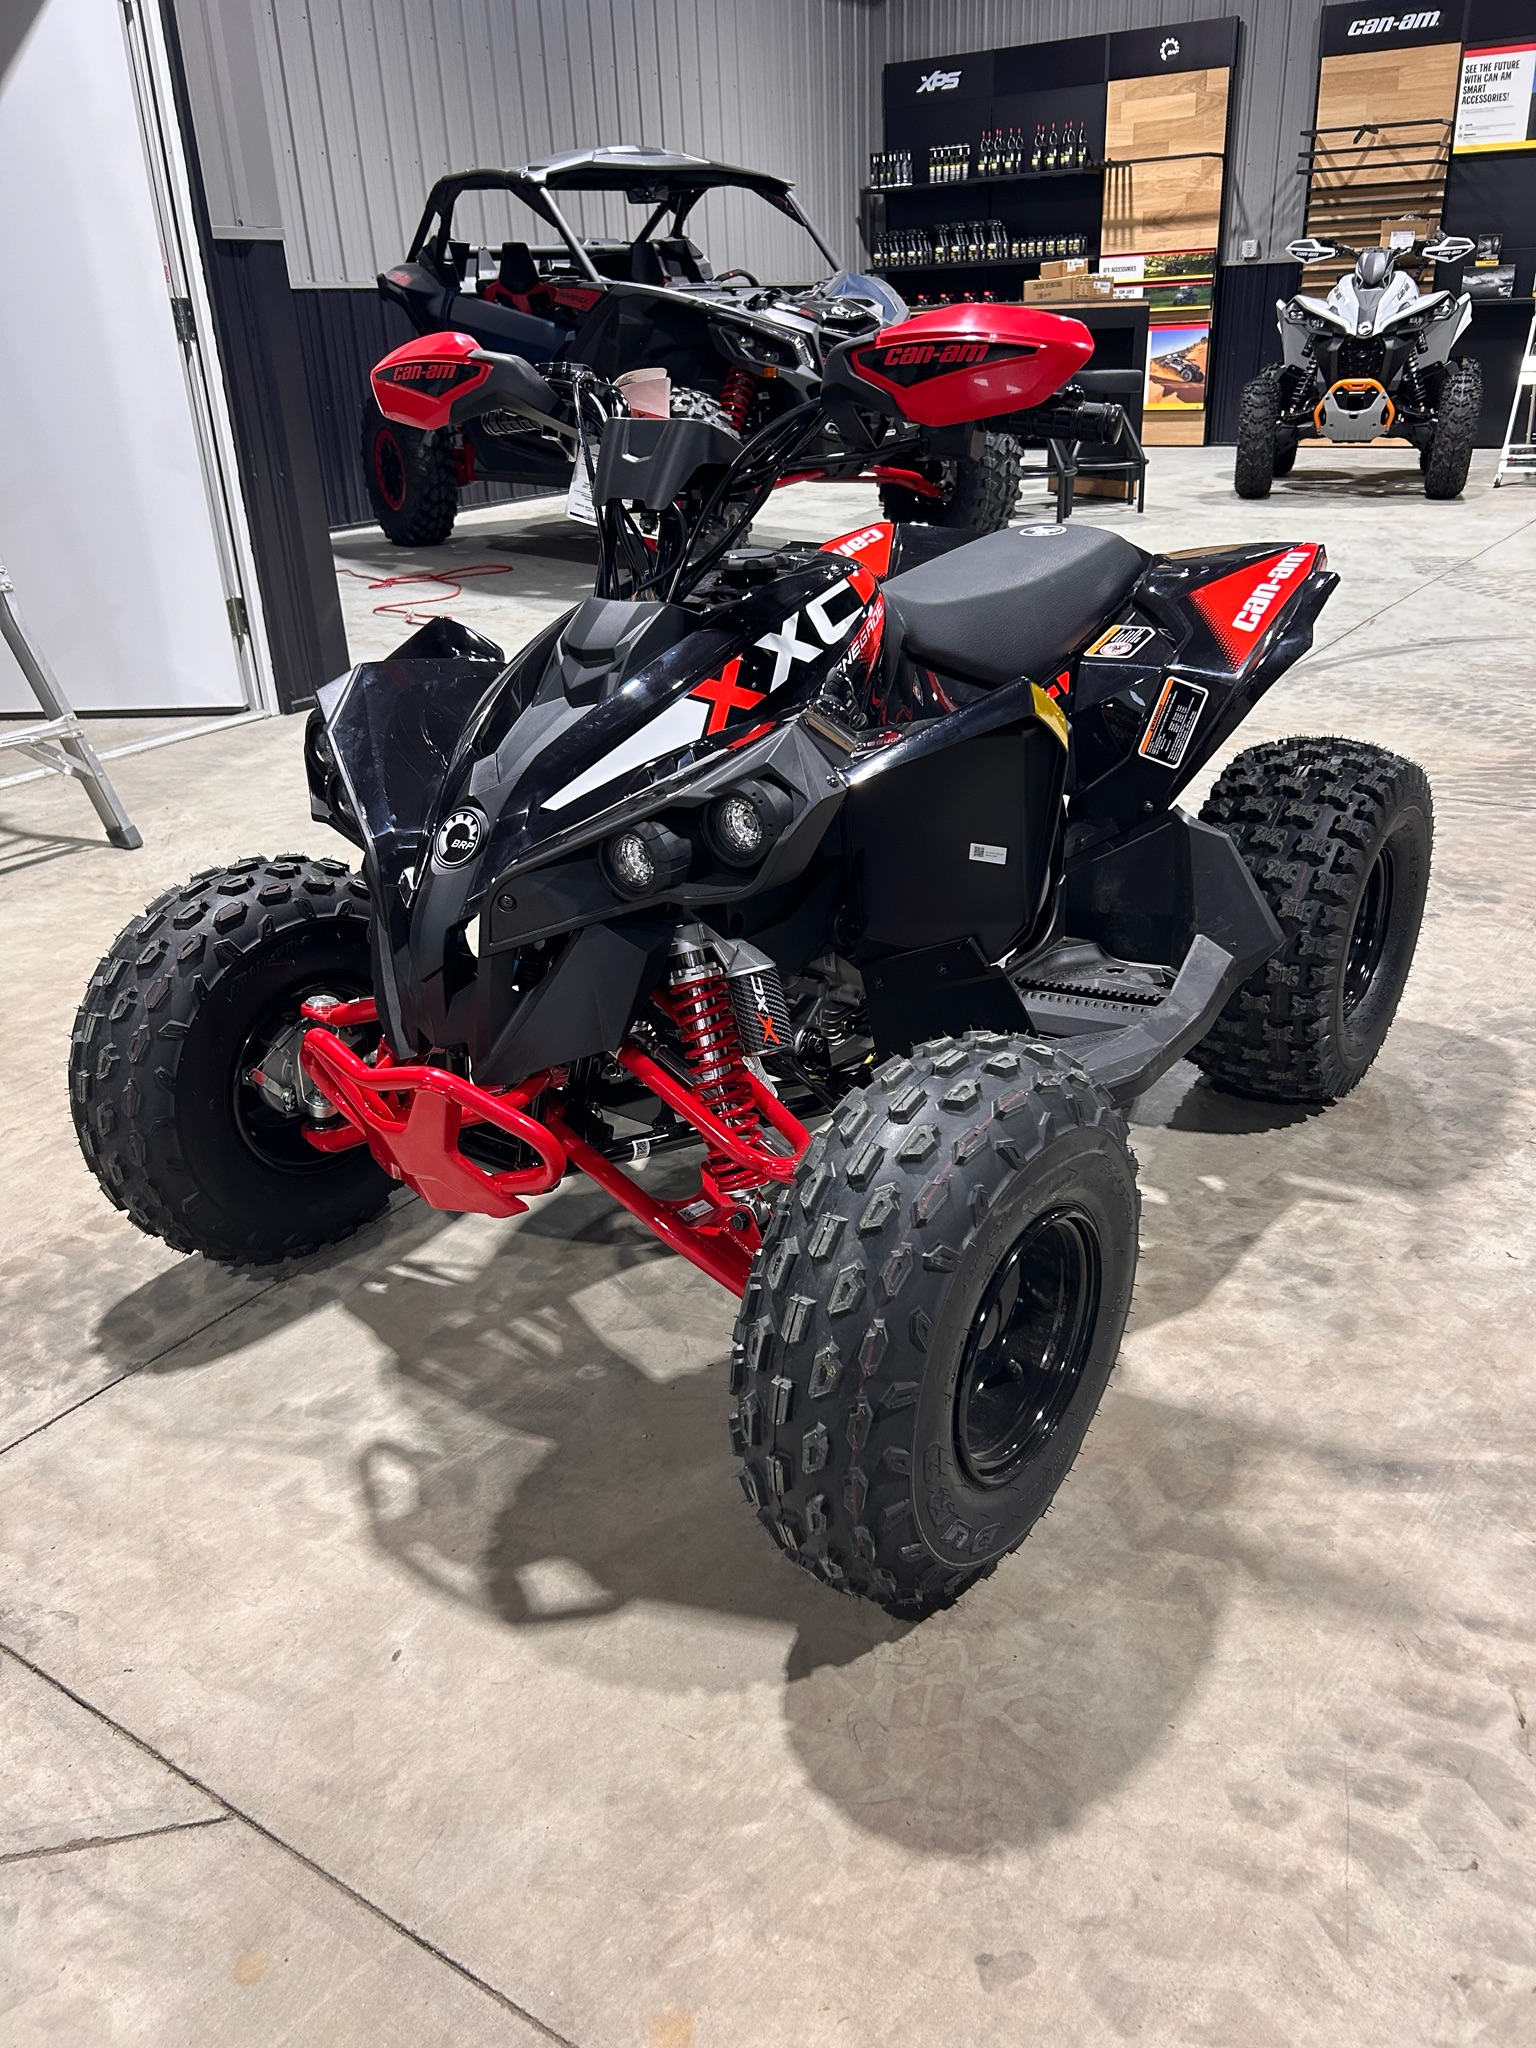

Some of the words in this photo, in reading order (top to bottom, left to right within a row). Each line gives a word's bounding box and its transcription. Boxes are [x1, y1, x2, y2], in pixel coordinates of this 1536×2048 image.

[1347, 10, 1441, 36] can-am
[1465, 64, 1477, 74] SEE
[1480, 62, 1492, 72] THE
[1494, 59, 1520, 71] FUTURE
[915, 70, 962, 93] XPS
[1464, 74, 1482, 84] WITH
[1463, 84, 1487, 95] SMART
[1461, 92, 1510, 105] ACCESSORIES!
[884, 344, 989, 366] can-am
[393, 364, 457, 381] can-am
[1231, 551, 1311, 633] can-am
[450, 838, 475, 851] BRP
